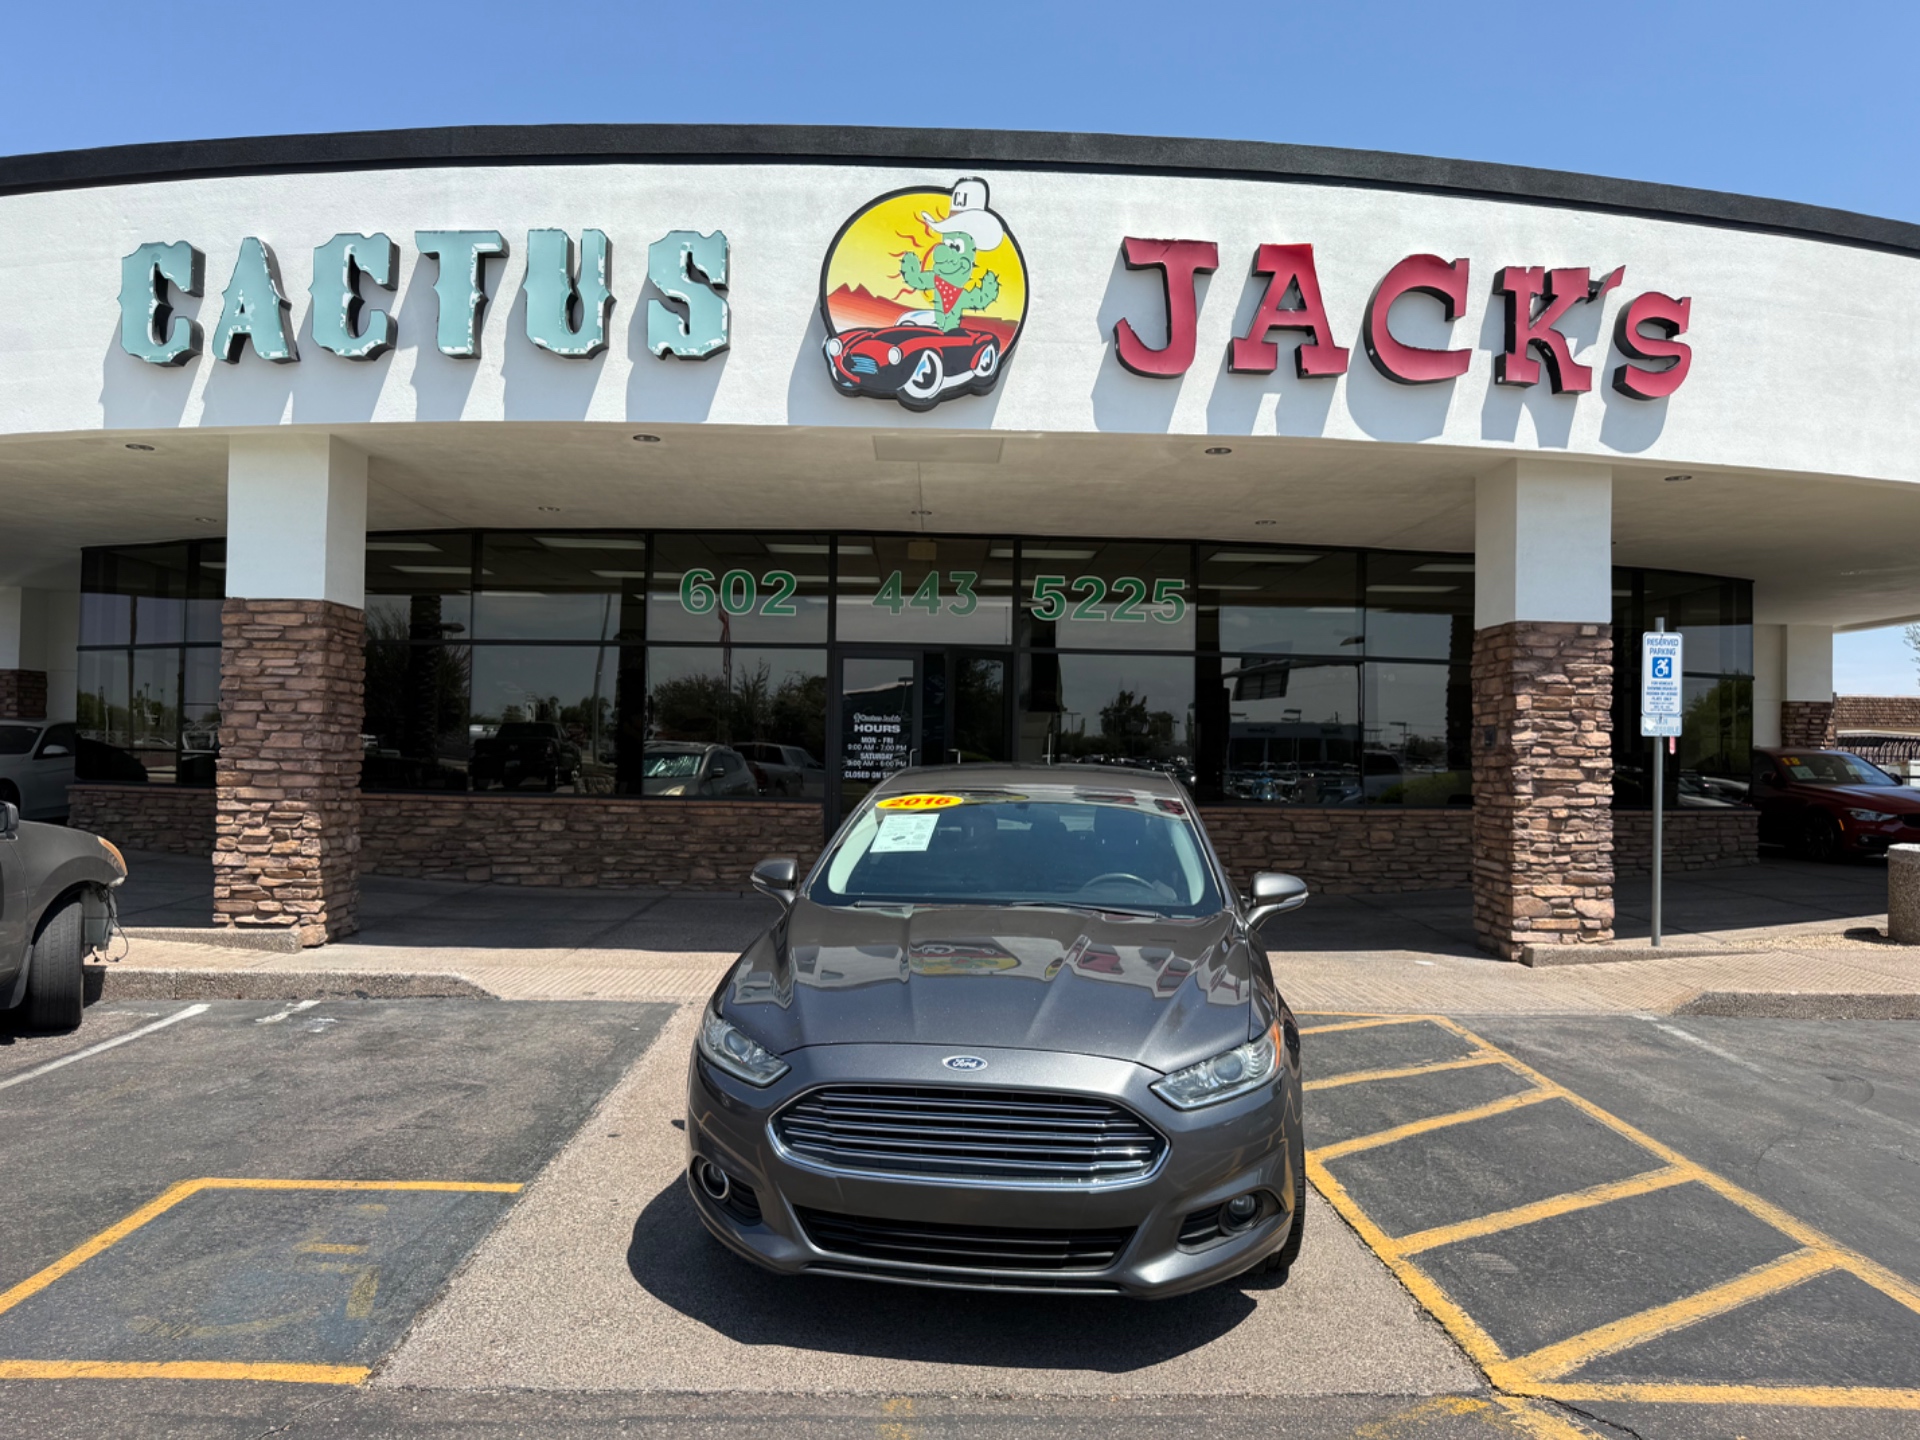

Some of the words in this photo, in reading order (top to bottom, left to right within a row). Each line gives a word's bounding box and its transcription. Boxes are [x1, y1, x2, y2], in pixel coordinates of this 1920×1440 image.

[953, 191, 968, 207] CJ
[118, 227, 730, 368] CACTUS
[679, 568, 798, 617] 602
[871, 570, 978, 617] 443
[1031, 575, 1186, 623] 5225
[1647, 638, 1679, 647] RESERVED
[1649, 647, 1676, 656] PARKING
[854, 724, 901, 734] HOURS
[860, 752, 894, 760] SATURDAY
[871, 771, 881, 779] ON
[886, 797, 953, 807] 2016
[952, 1058, 977, 1068] Ford
